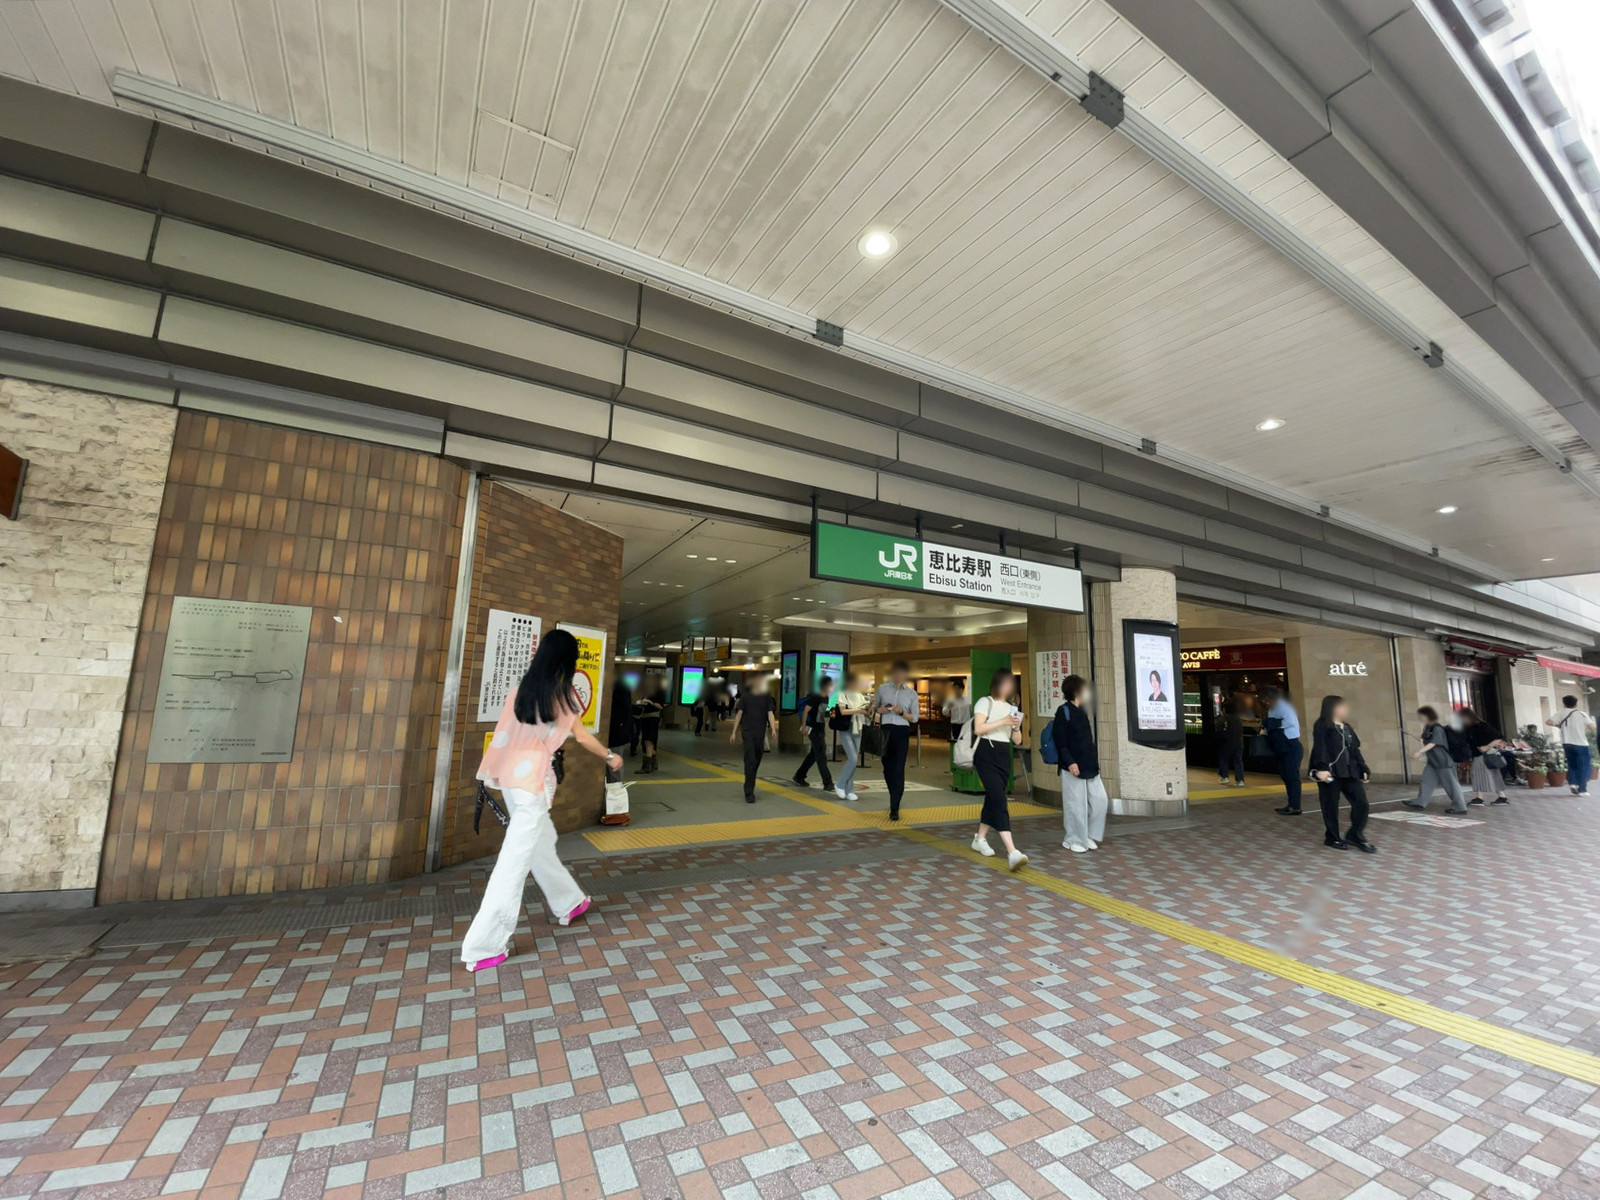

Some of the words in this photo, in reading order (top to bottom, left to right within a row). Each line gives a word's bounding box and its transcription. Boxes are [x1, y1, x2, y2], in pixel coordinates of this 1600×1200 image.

[879, 543, 917, 572] JR
[929, 550, 992, 578] 恵比寿駅
[884, 569, 913, 580] JR東日本
[929, 573, 957, 587] Ebisu
[960, 578, 992, 592] Station
[1001, 578, 1016, 587] West
[1017, 580, 1041, 592] Entrance
[1190, 648, 1220, 660] CAFFÈ
[1329, 661, 1367, 675] atré
